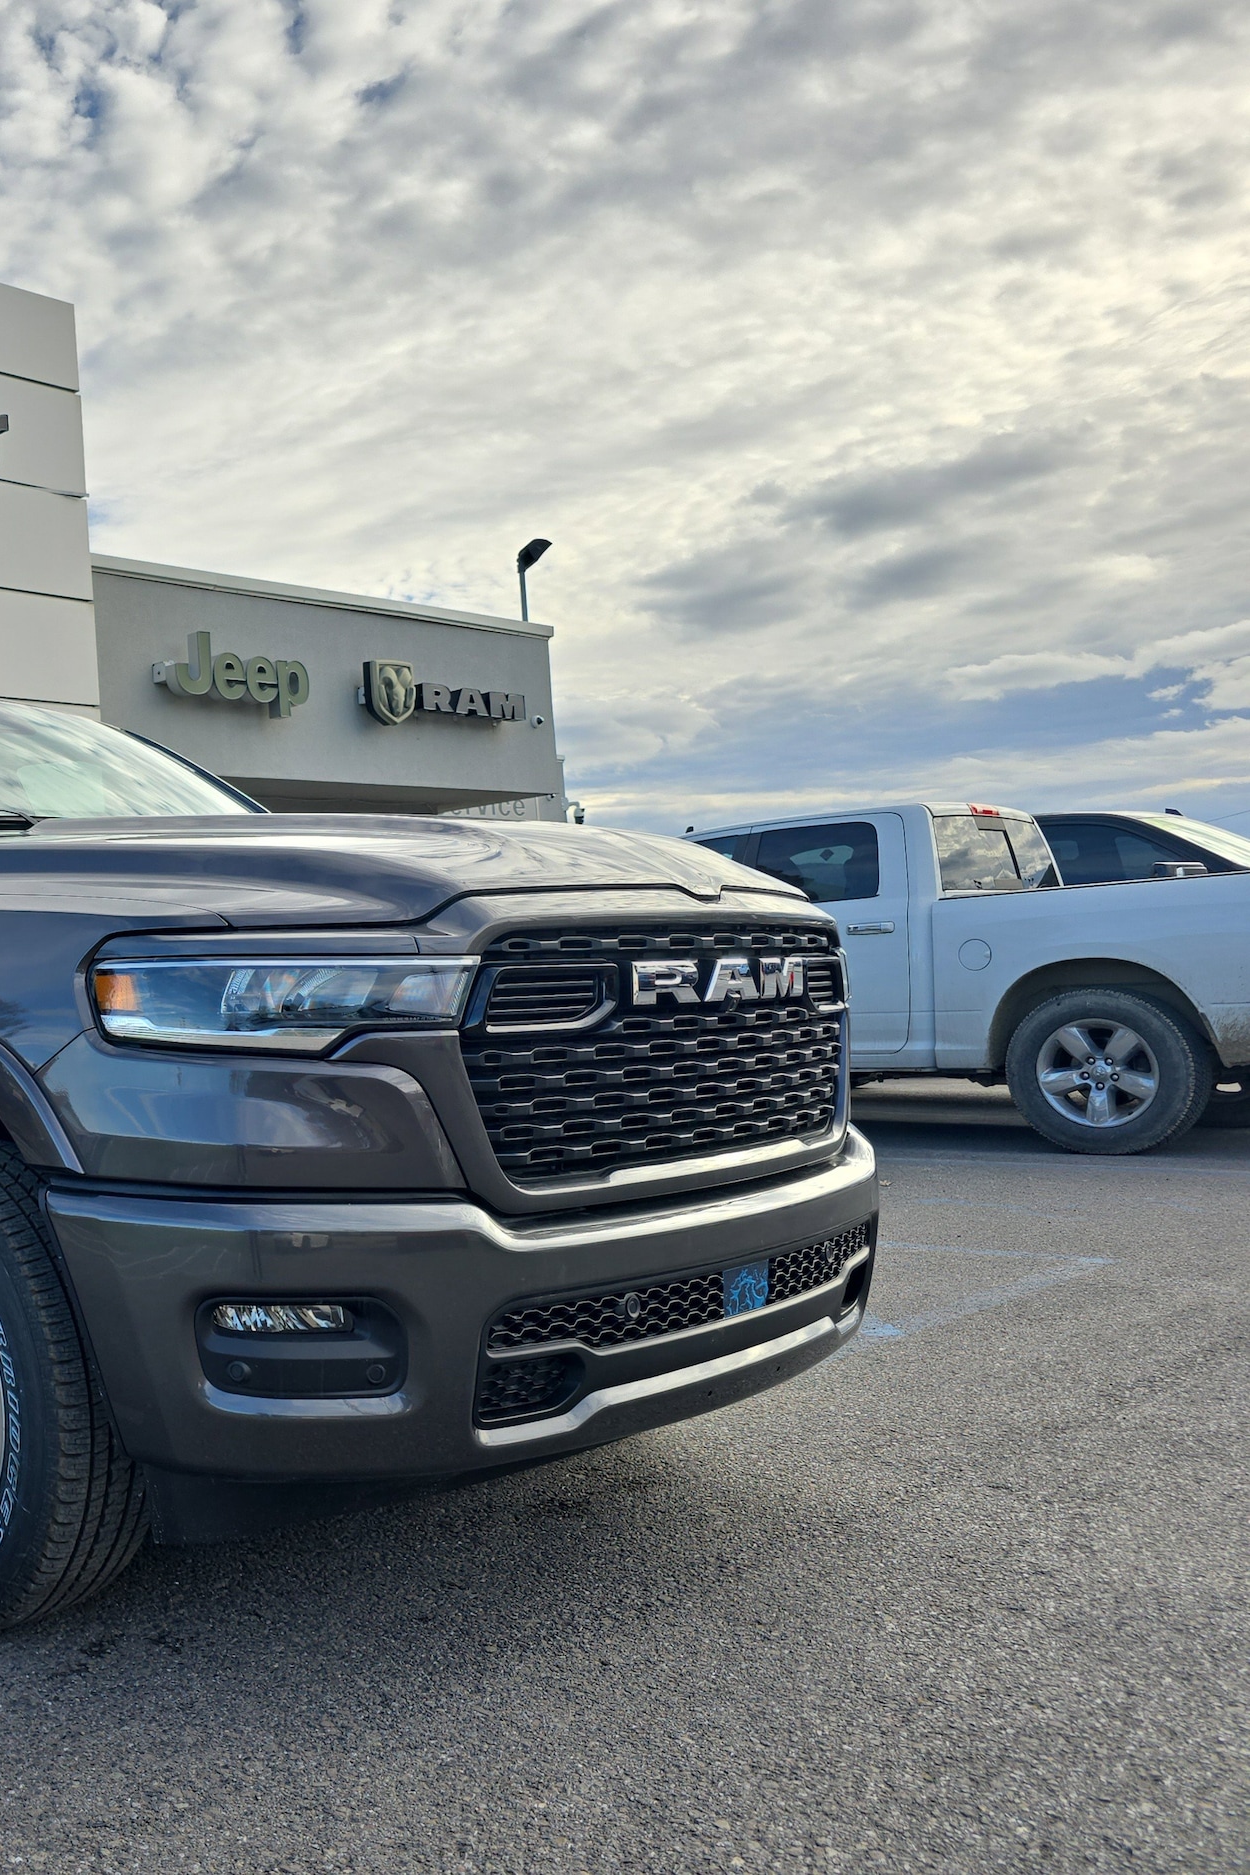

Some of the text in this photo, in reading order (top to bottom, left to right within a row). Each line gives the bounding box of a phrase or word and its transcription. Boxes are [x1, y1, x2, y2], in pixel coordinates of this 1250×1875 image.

[166, 631, 309, 719] Jeep
[415, 682, 526, 721] RAM
[631, 957, 804, 1006] RAM
